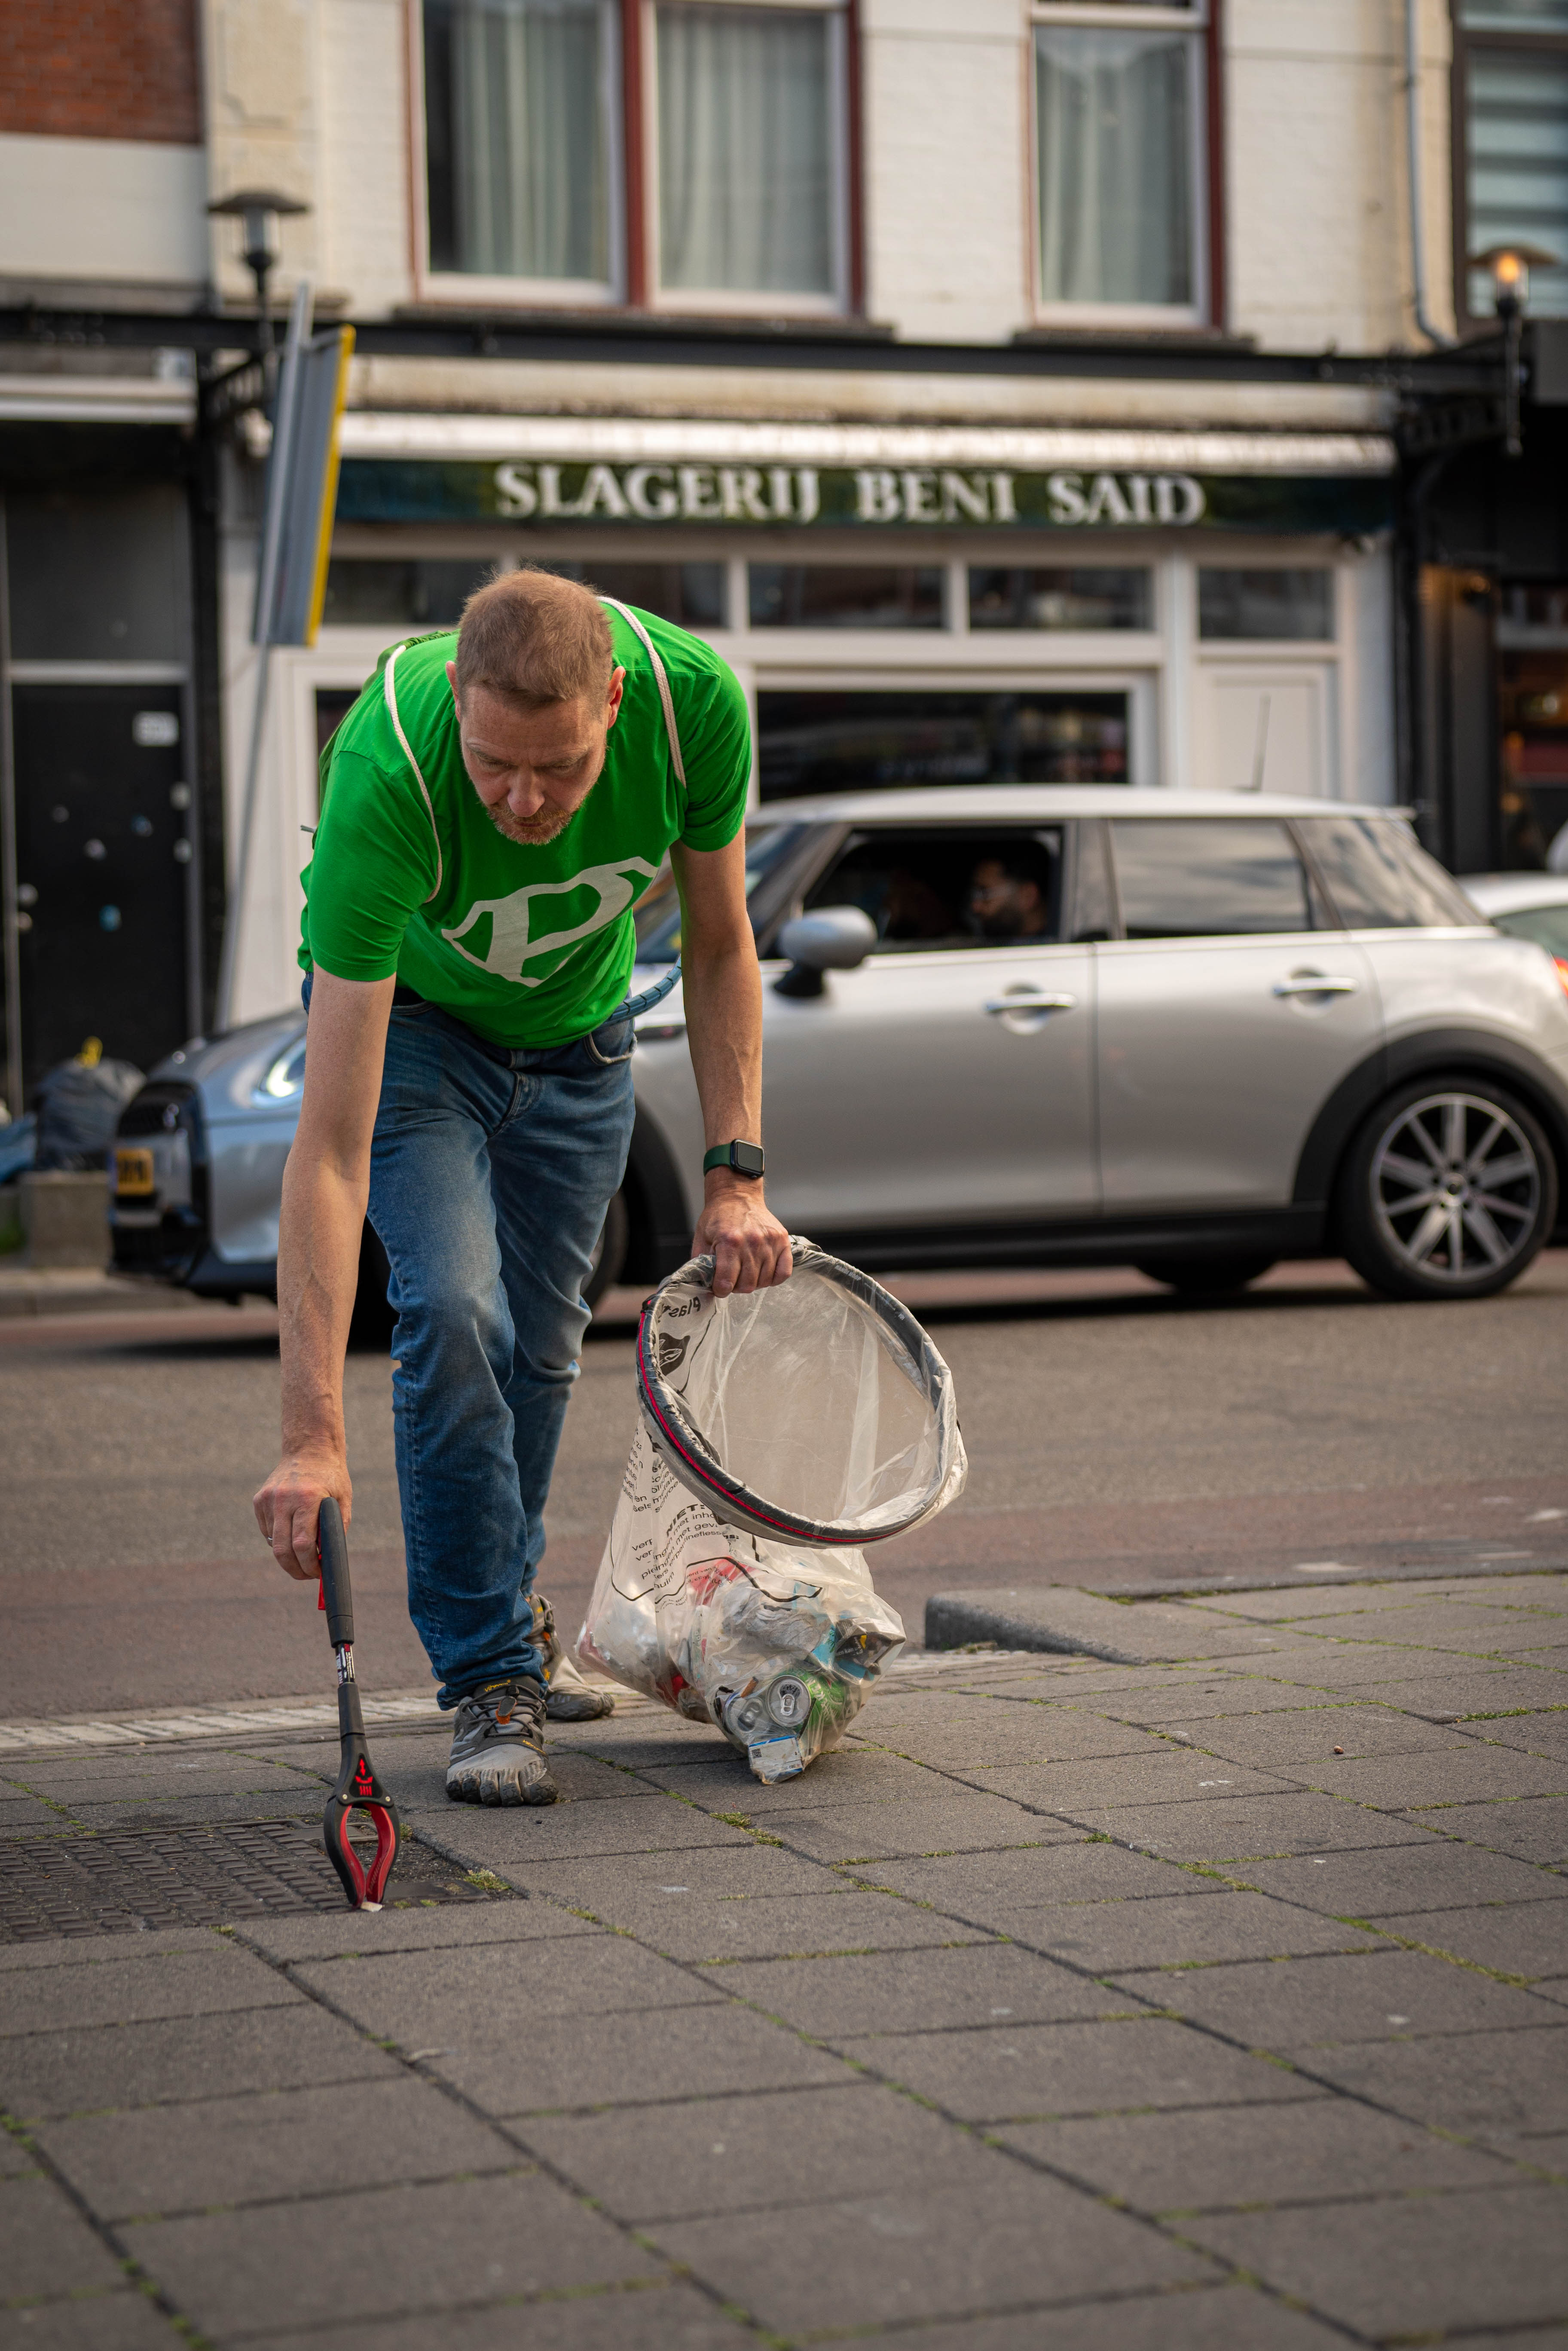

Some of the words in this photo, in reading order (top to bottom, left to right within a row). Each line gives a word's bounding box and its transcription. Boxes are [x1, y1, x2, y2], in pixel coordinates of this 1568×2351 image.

[494, 462, 819, 524] SLAGERIJ
[856, 469, 1018, 523] BENI
[1046, 472, 1206, 526] SAID
[666, 1503, 706, 1537] NIET:
